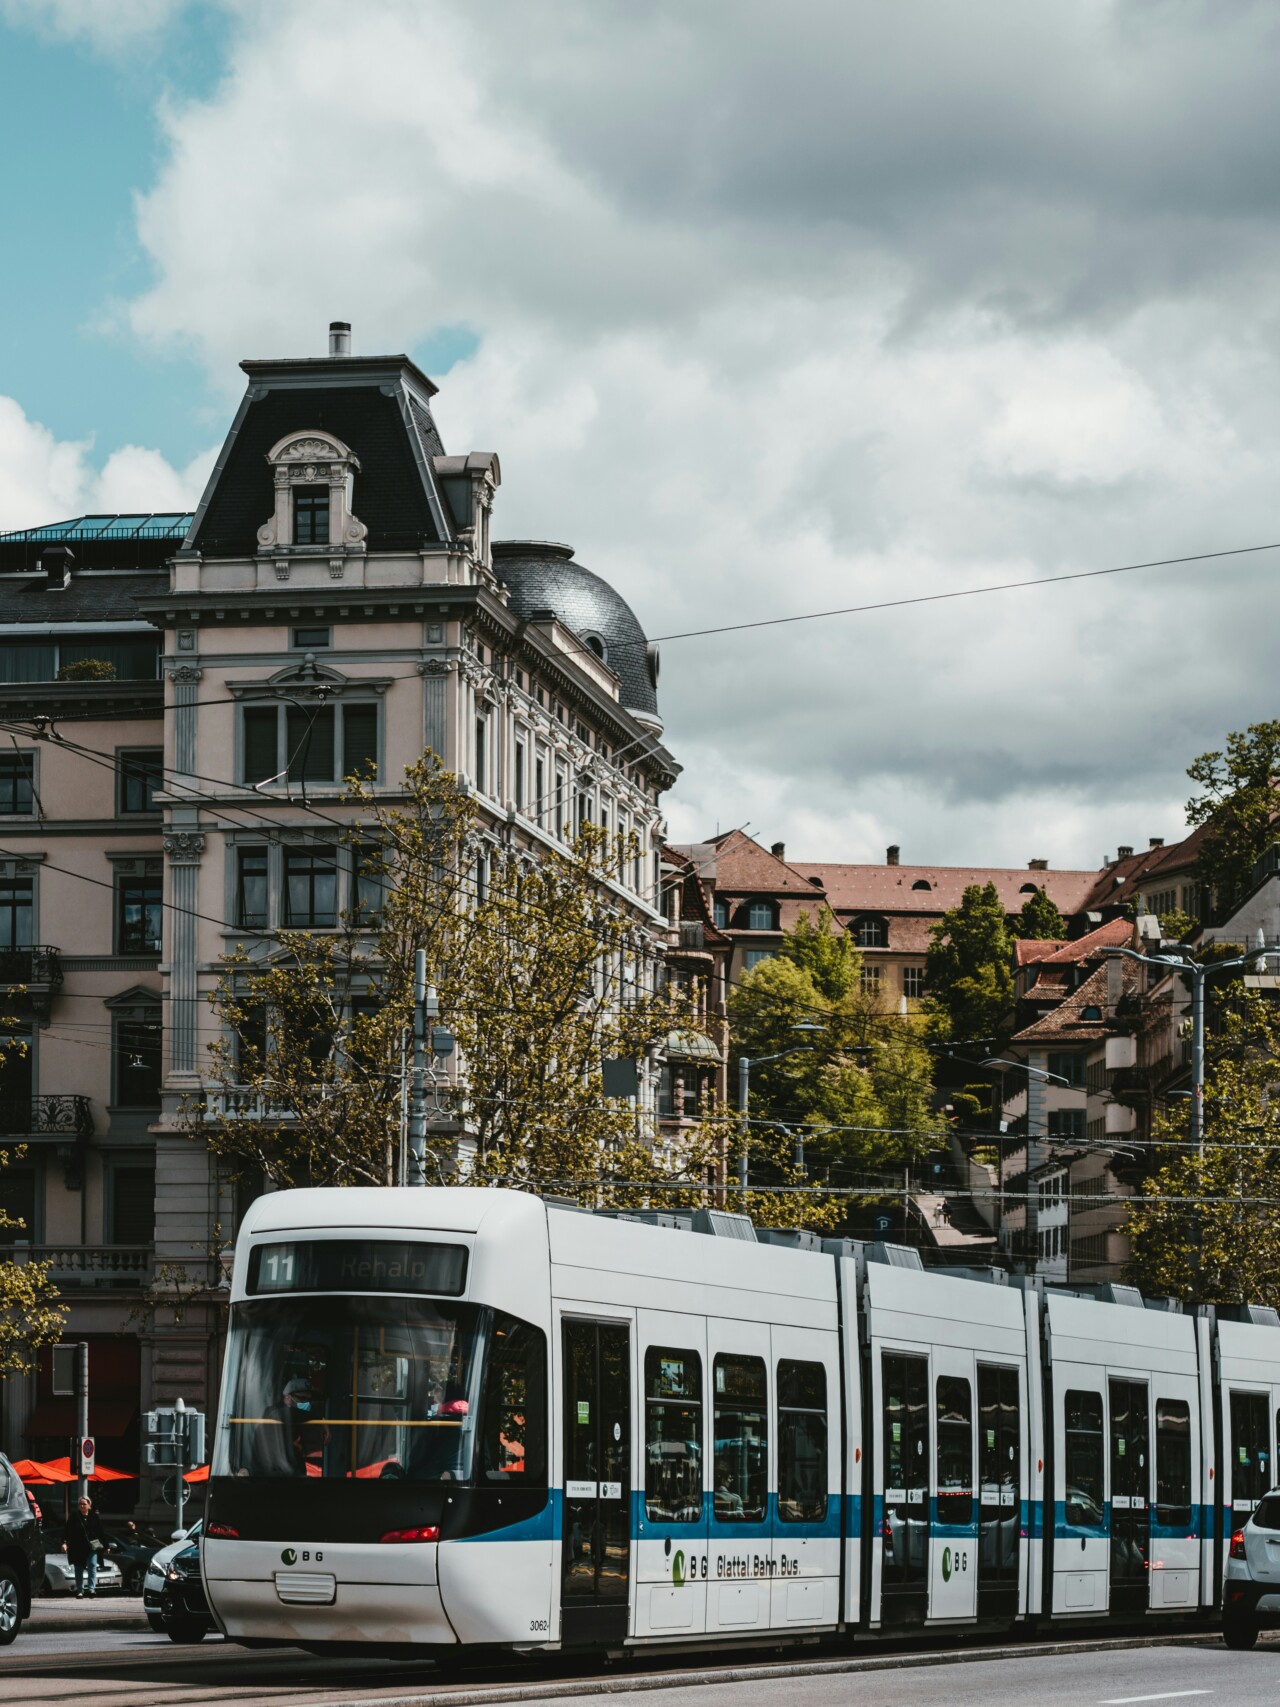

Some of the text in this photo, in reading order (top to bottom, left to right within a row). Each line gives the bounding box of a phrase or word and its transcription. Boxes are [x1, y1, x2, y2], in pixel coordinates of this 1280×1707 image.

[267, 1254, 426, 1281] 11 Rehalp
[530, 1620, 548, 1631] 3062
